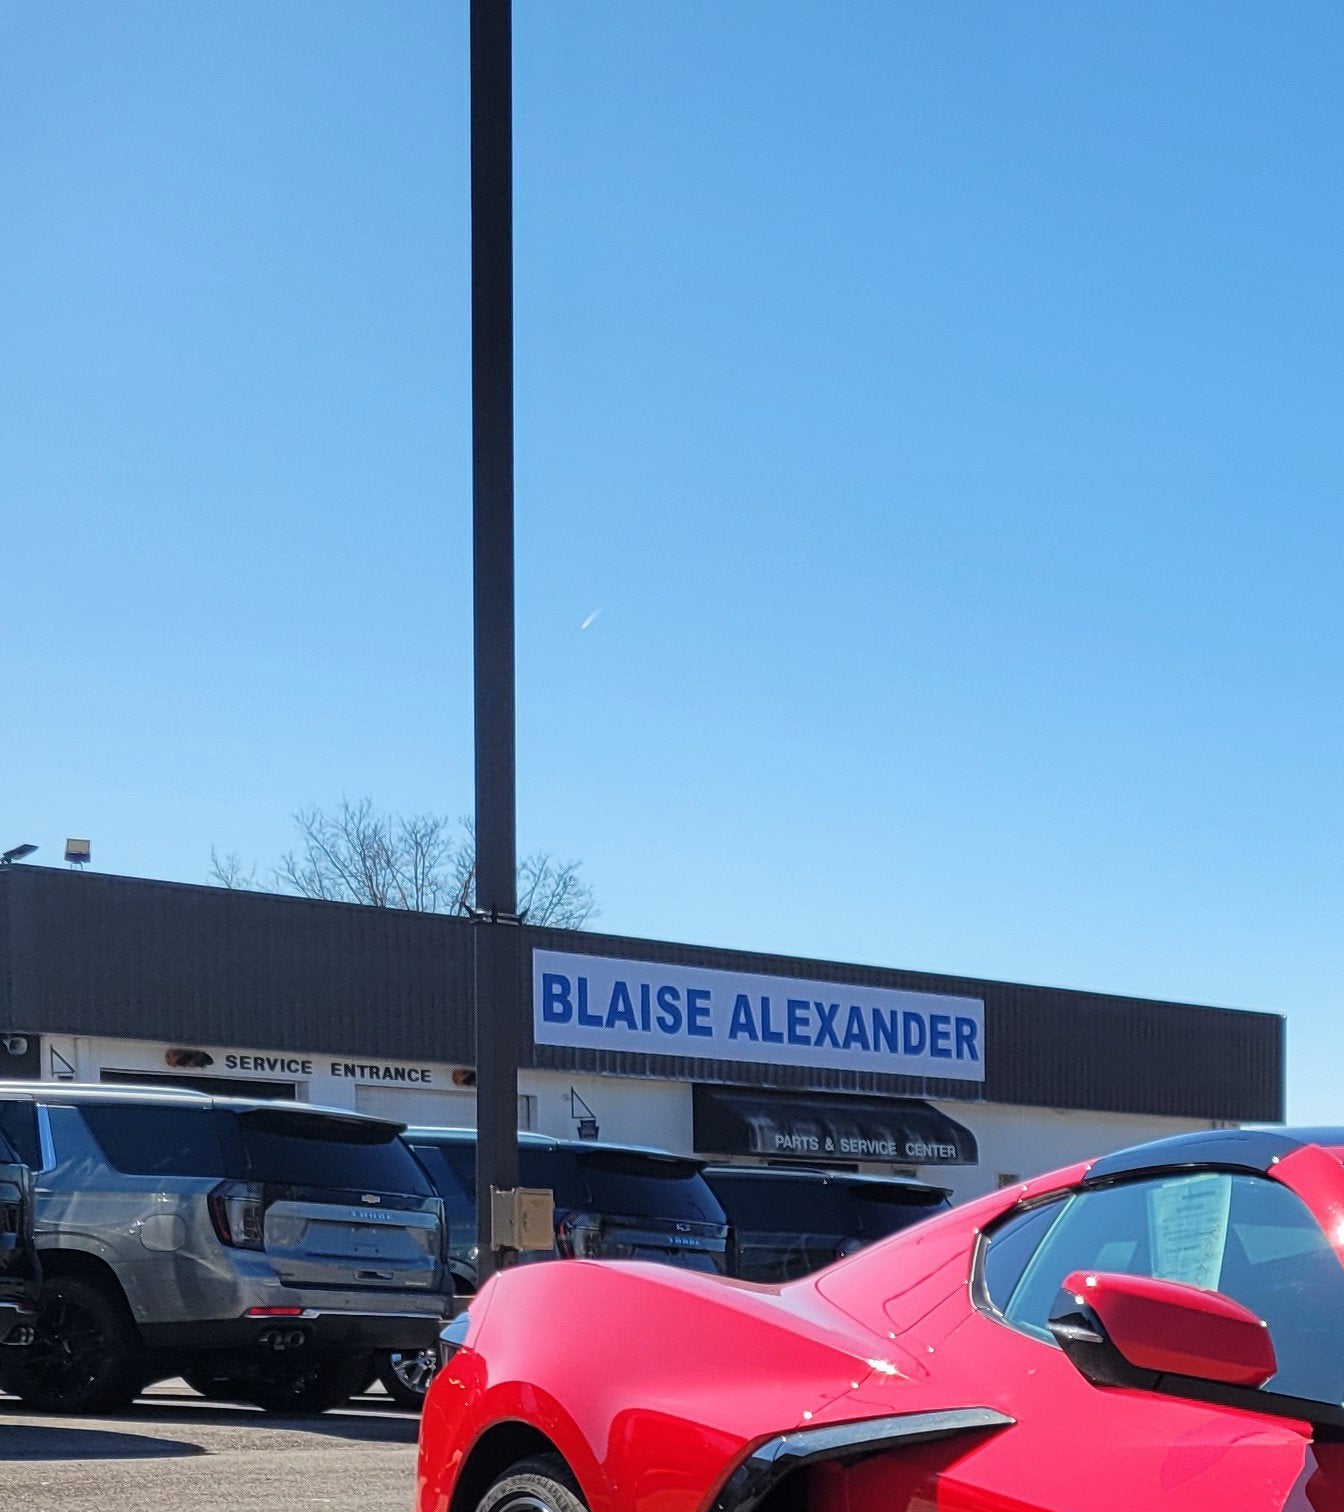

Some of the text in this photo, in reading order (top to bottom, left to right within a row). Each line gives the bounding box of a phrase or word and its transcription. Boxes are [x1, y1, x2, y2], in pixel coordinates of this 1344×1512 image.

[541, 971, 980, 1062] BLAISE ALEXANDER
[225, 1055, 433, 1083] SERVICE ENTRANCE
[775, 1134, 957, 1158] PARTS & SERVICE CENTER
